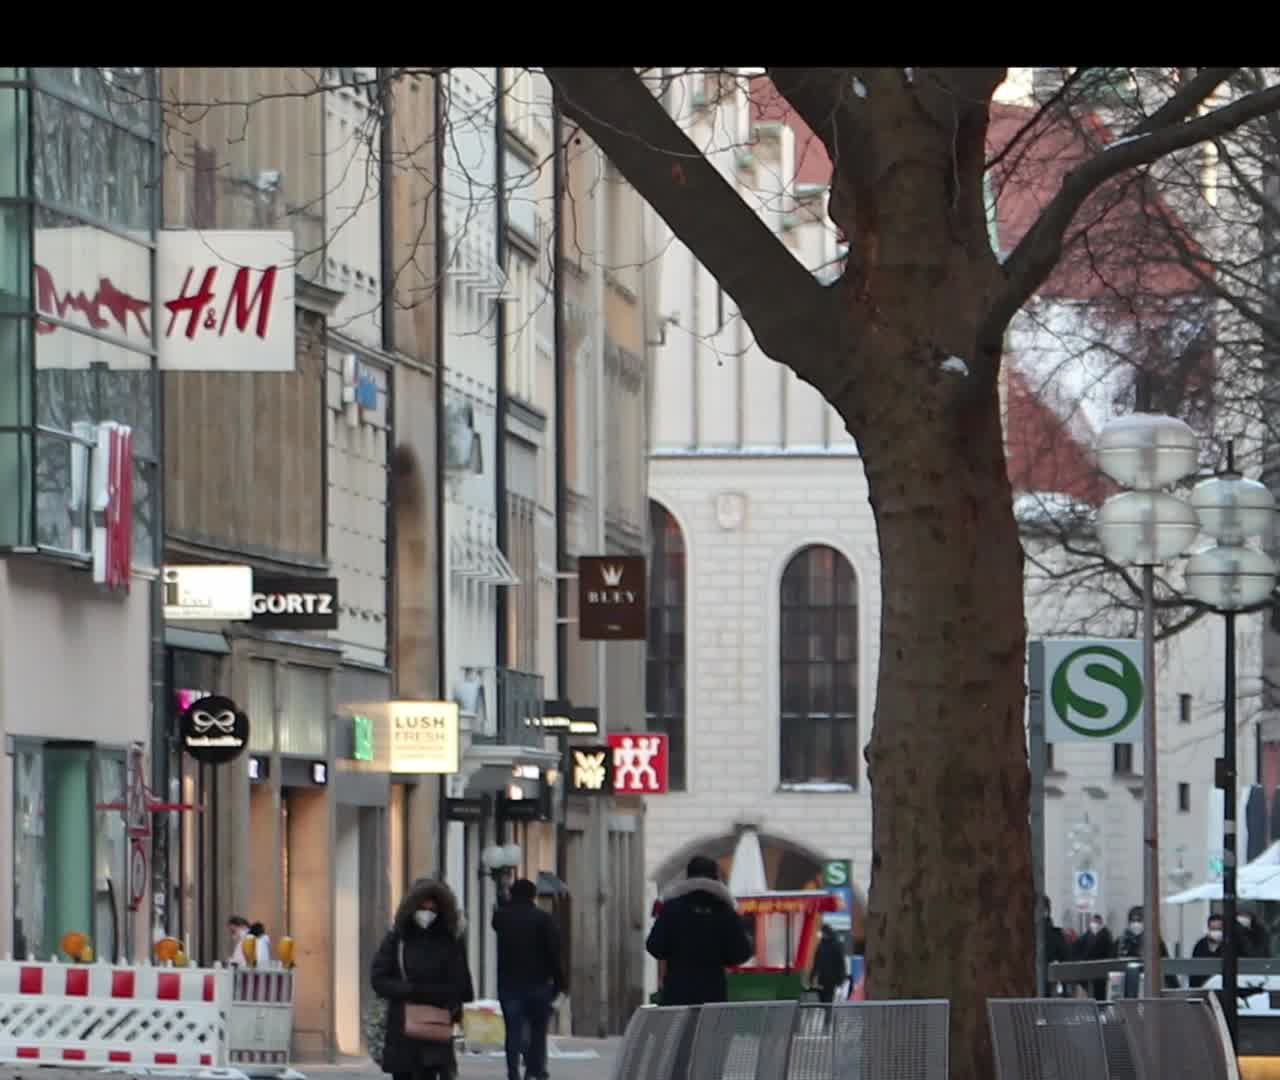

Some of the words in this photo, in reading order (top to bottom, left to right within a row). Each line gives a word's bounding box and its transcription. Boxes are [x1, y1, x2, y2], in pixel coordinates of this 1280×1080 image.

[164, 265, 277, 340] H&M
[395, 715, 445, 729] LUSH
[1066, 654, 1128, 730] S
